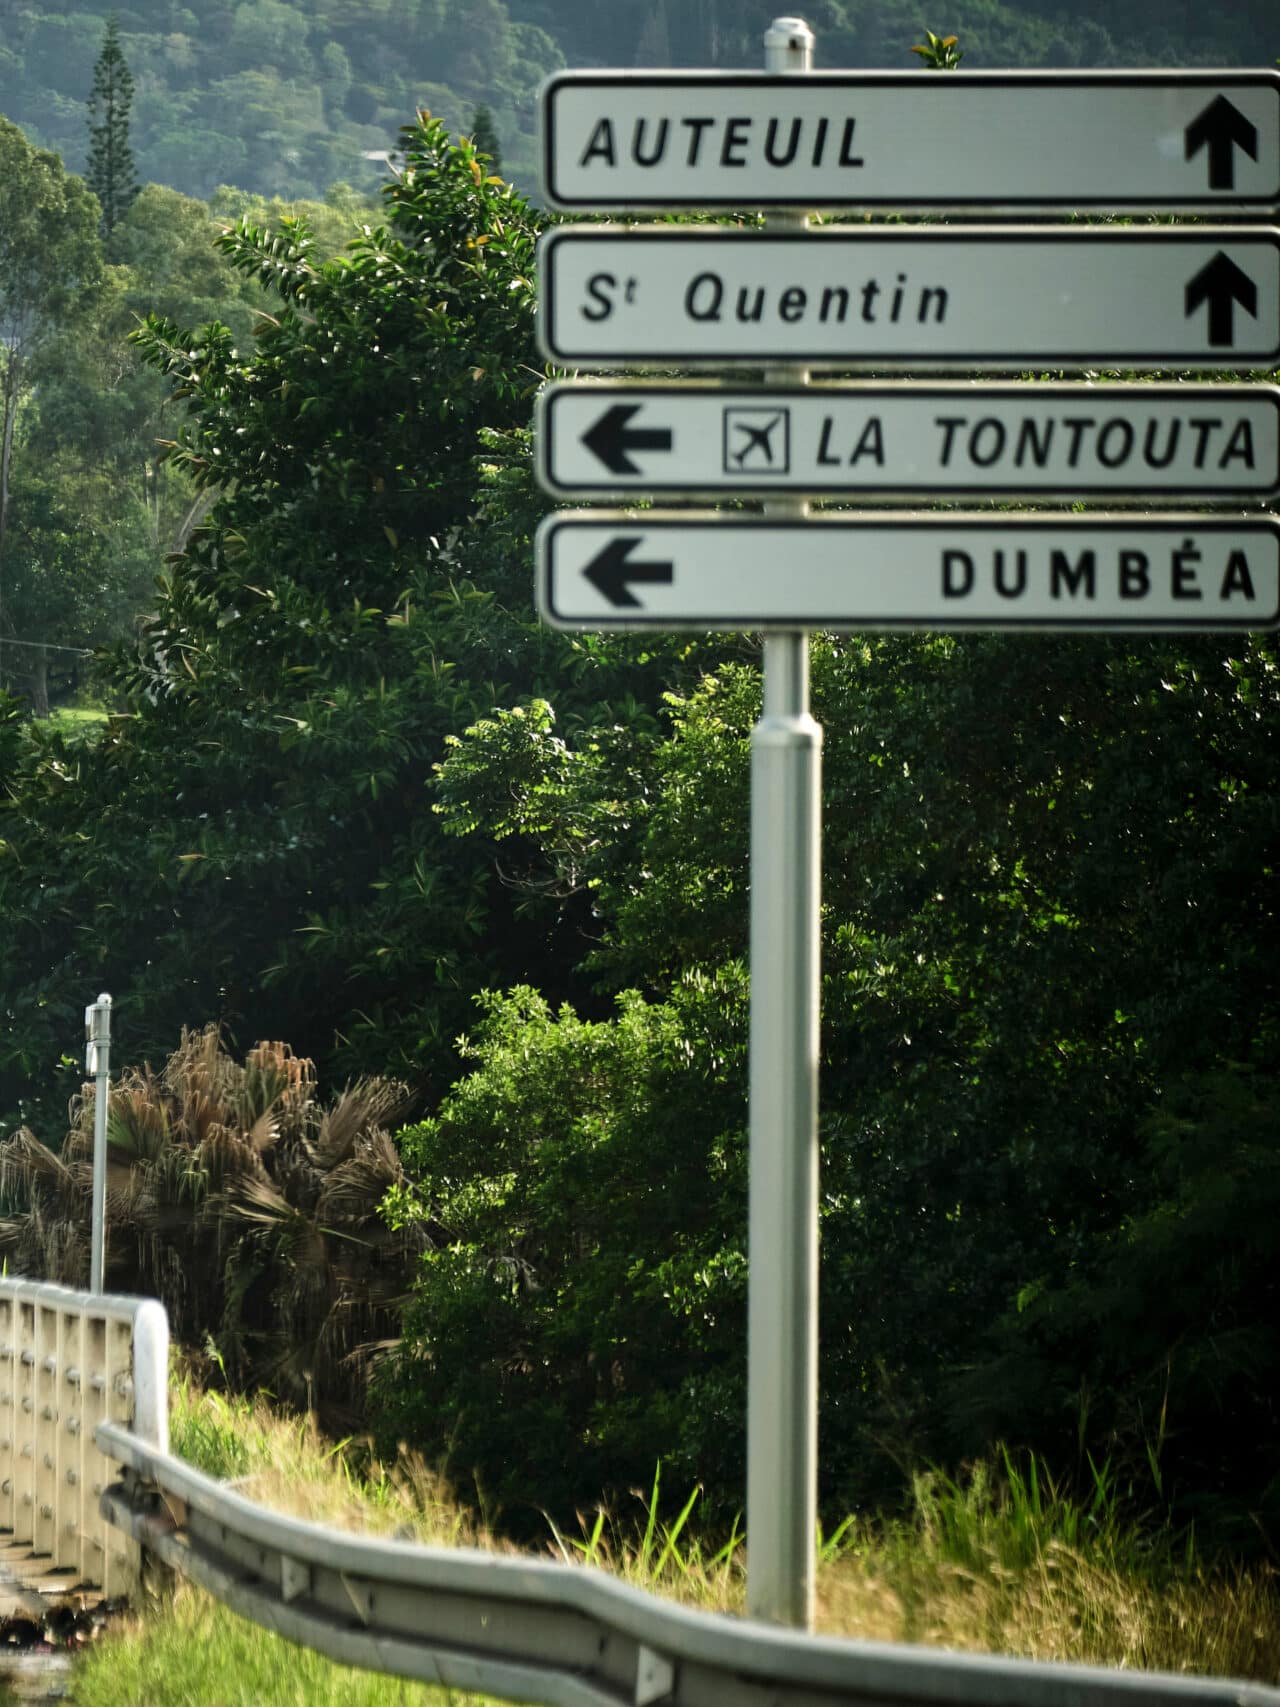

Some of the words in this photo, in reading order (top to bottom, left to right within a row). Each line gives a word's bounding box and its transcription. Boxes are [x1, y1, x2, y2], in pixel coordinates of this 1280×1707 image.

[581, 117, 865, 168] AUTEUIL
[582, 273, 639, 322] St
[685, 272, 949, 324] Quentin
[816, 417, 886, 466] LA
[935, 416, 1257, 470] TONTOUTA
[941, 538, 1257, 601] DUMBÉA
